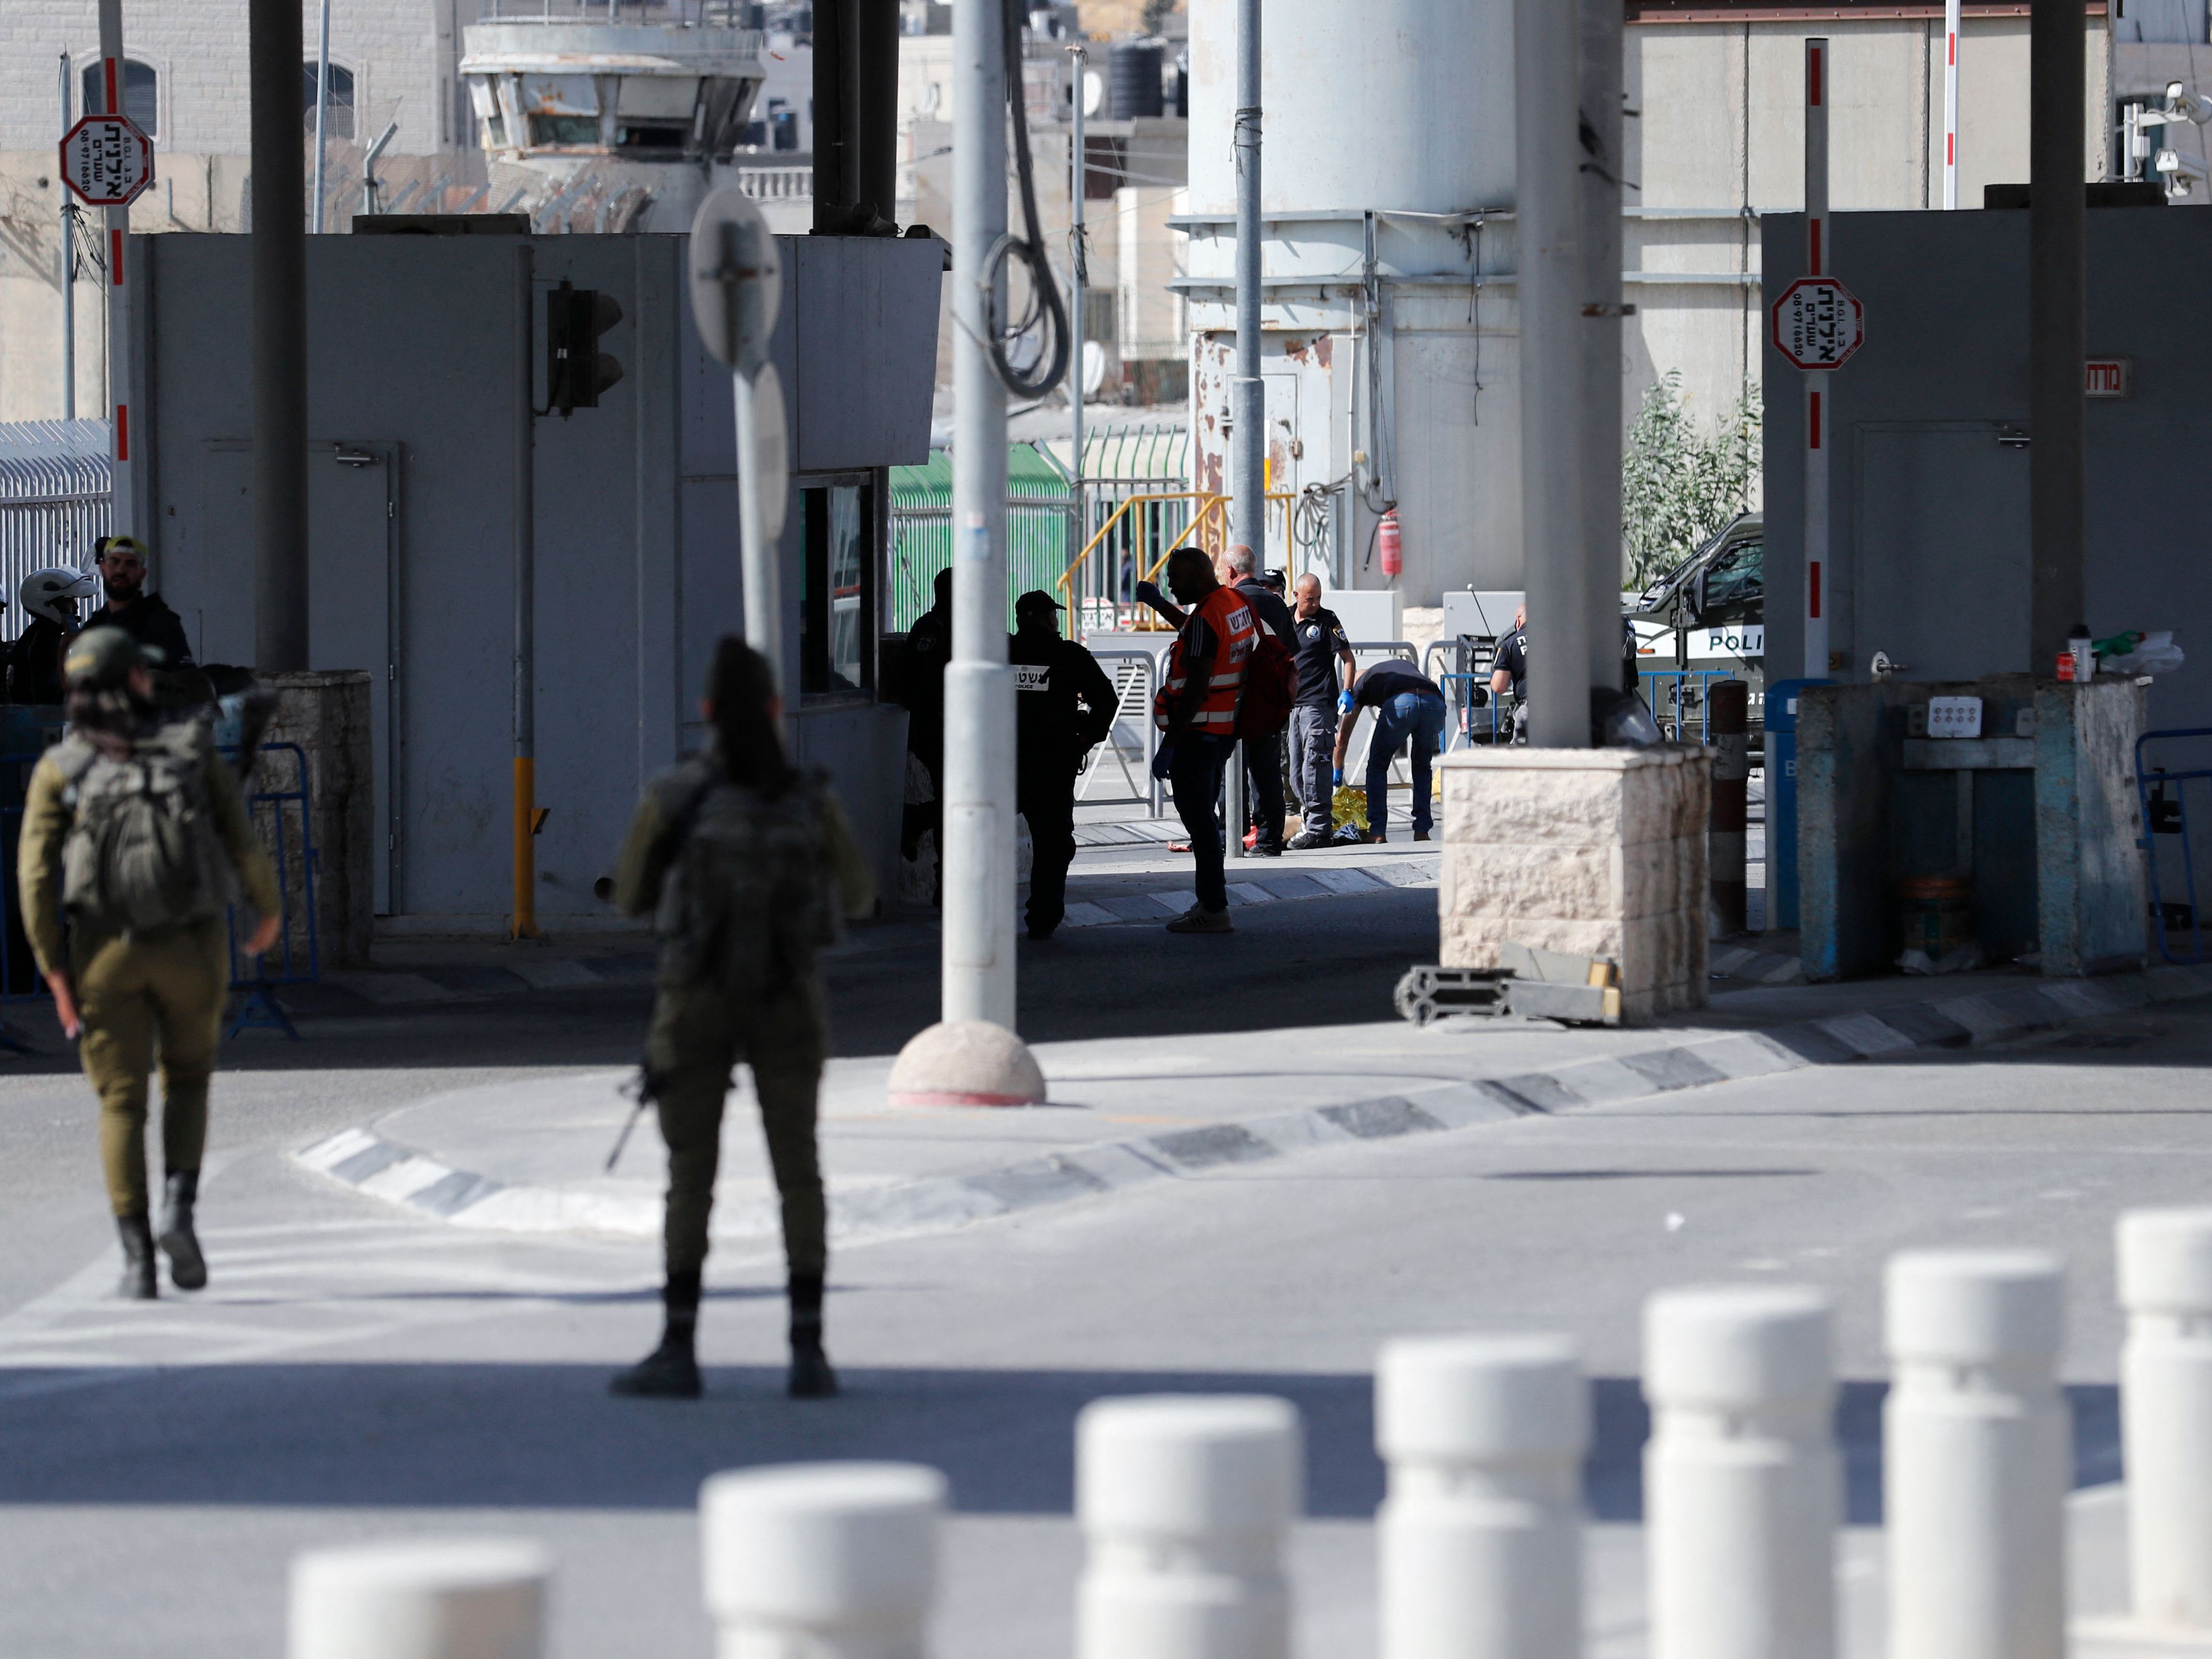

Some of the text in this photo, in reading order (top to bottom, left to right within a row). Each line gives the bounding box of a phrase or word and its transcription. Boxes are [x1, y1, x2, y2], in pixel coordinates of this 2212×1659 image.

[81, 130, 91, 192] 08-9716620
[93, 139, 103, 182] שערים
[104, 124, 123, 197] אילנית
[1793, 293, 1803, 356] 08-9716620
[1806, 303, 1816, 346] שערים
[1818, 288, 1836, 361] אילנית
[2087, 364, 2120, 390] מרח
[1710, 635, 1762, 651] POLI
